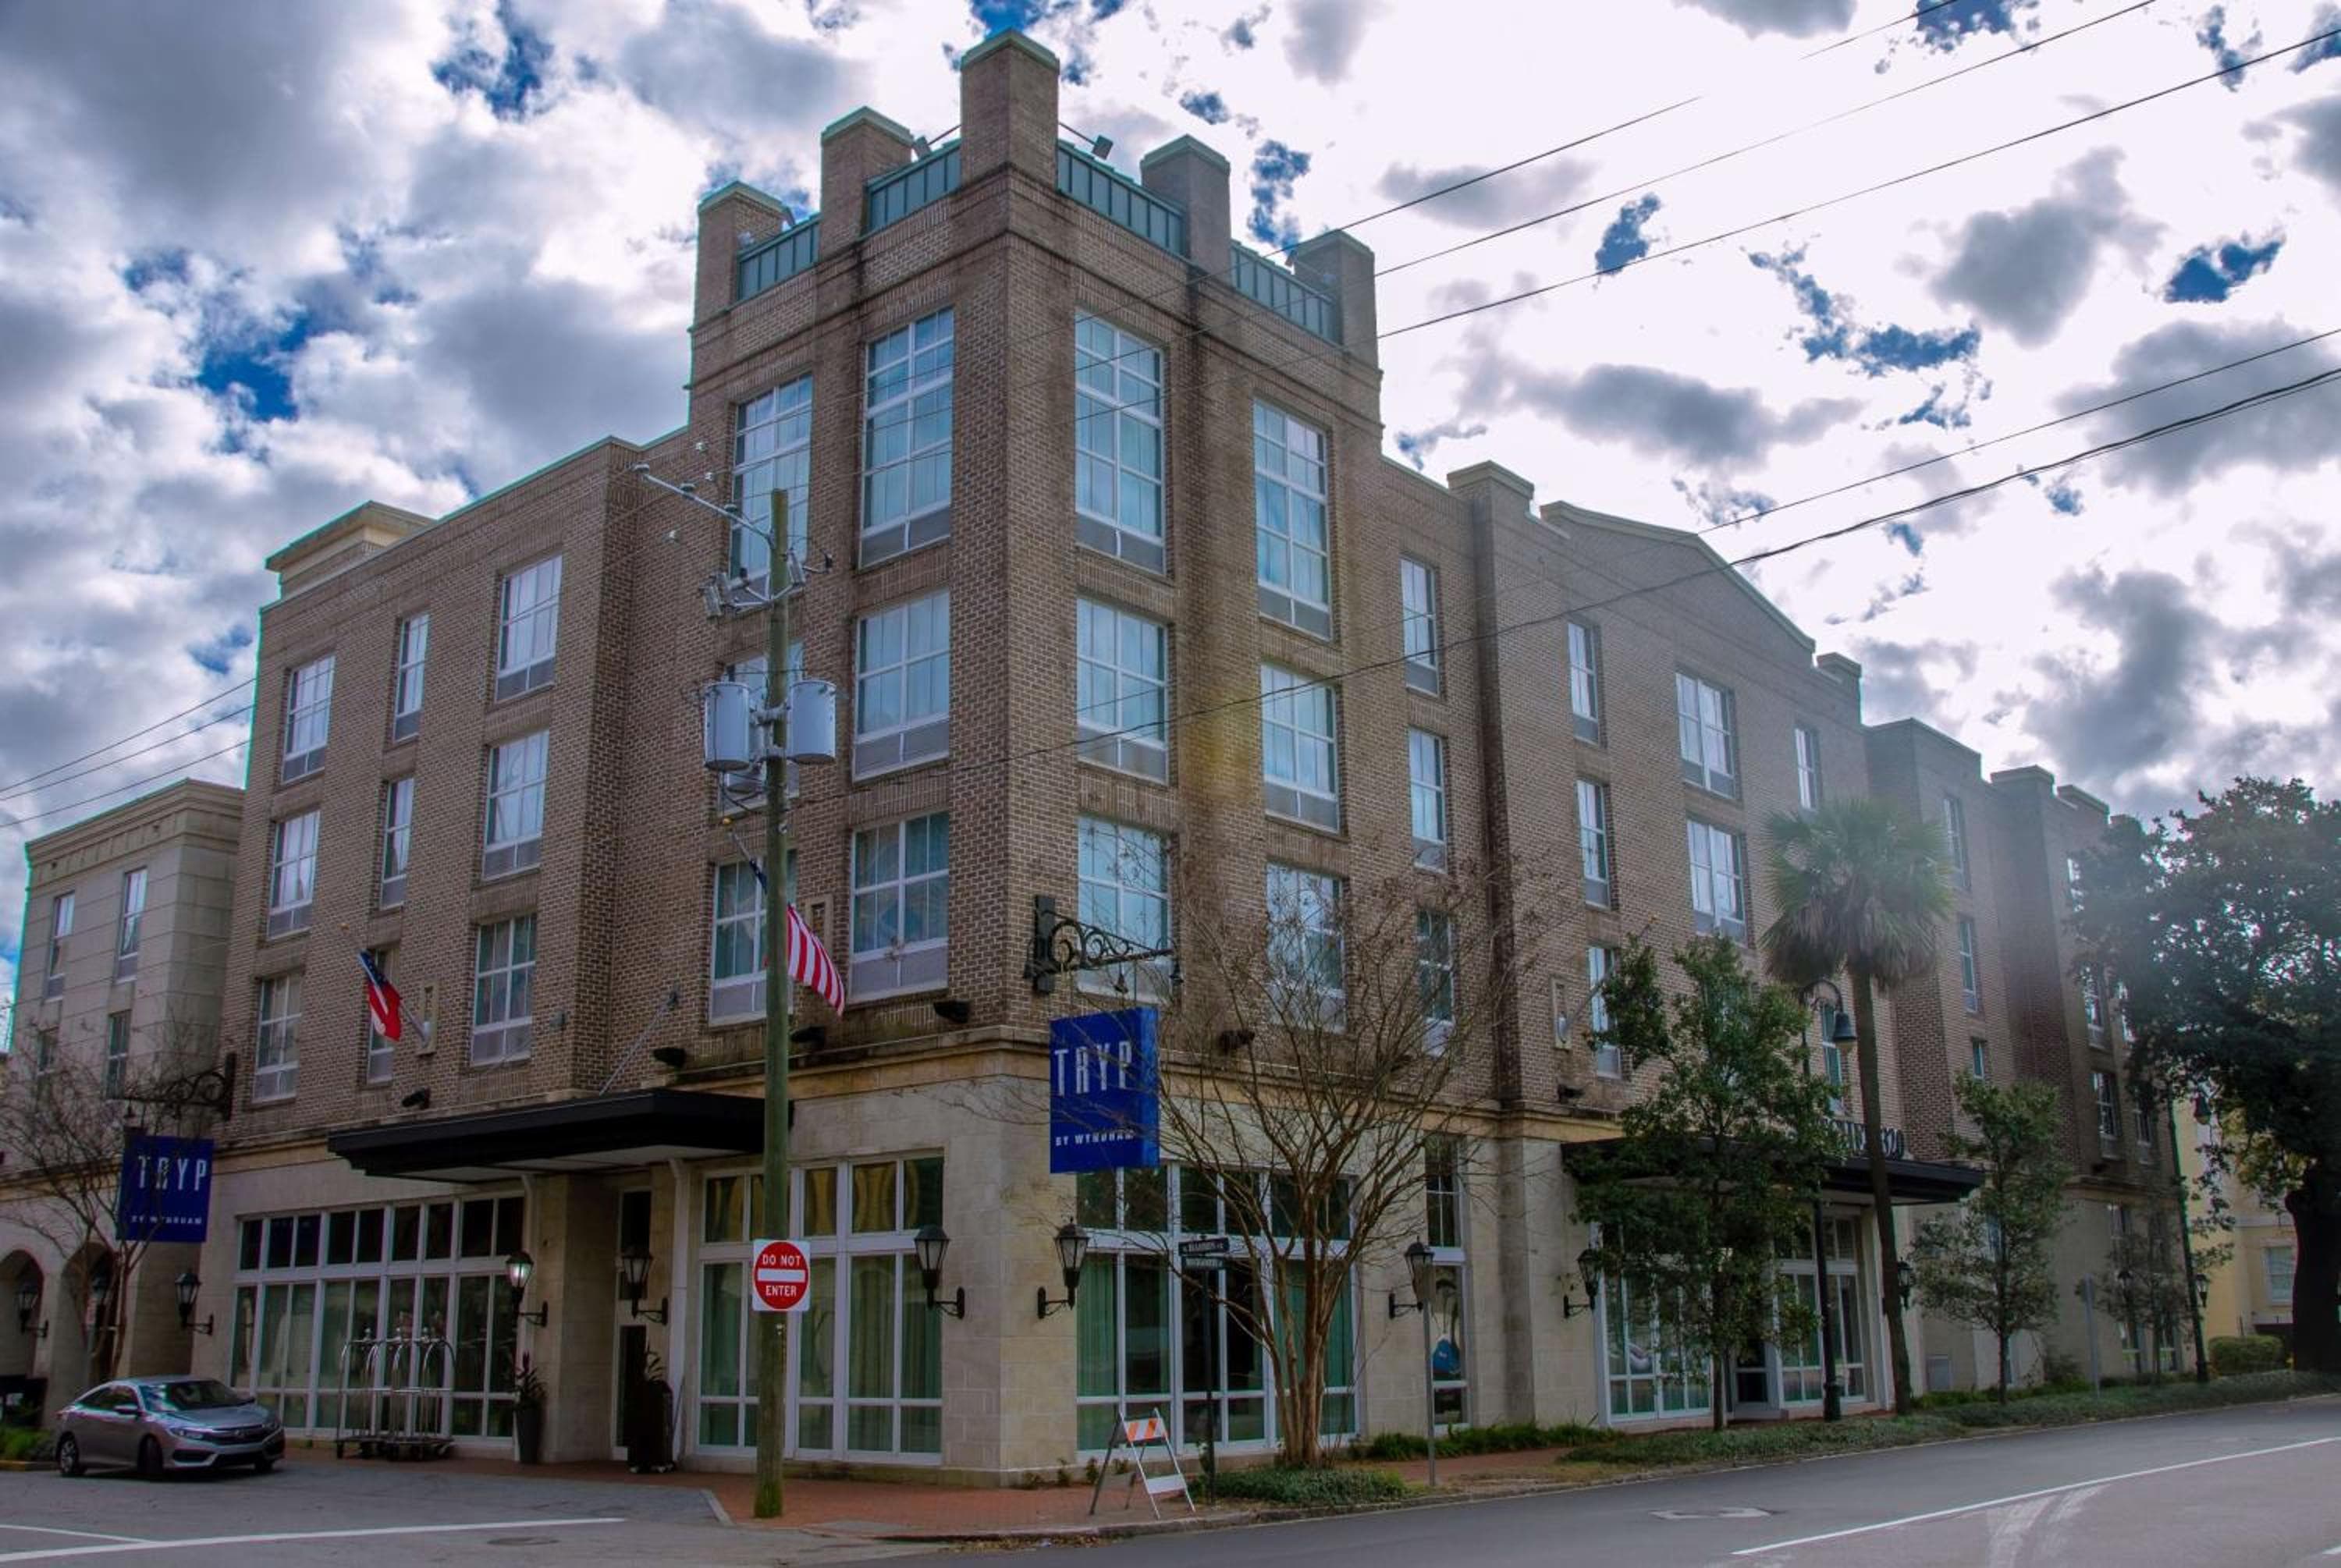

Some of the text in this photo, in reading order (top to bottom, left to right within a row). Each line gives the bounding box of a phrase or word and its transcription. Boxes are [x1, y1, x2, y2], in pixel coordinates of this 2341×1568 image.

[1053, 1040, 1133, 1097] TRYP
[1055, 1136, 1069, 1147] BY
[137, 1155, 208, 1191] TRYP
[762, 1254, 801, 1266] DO NOT
[766, 1285, 797, 1297] ENTER
